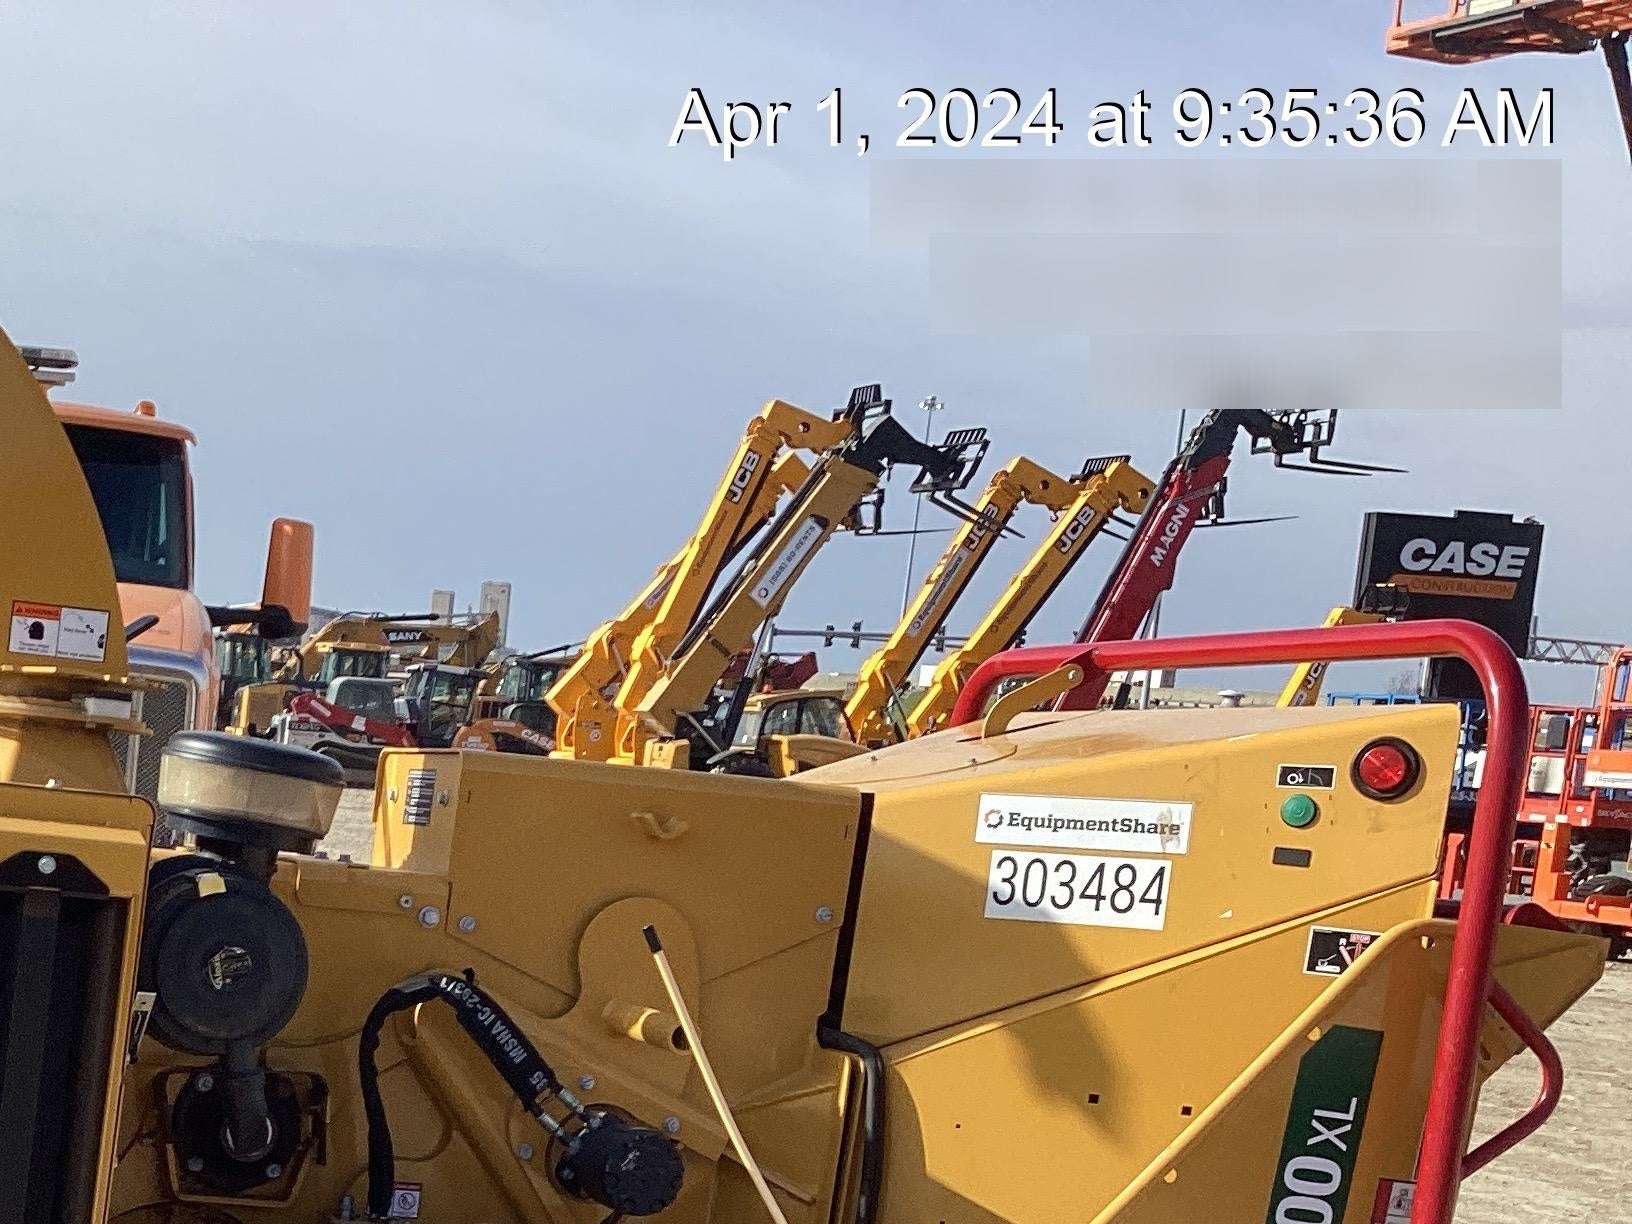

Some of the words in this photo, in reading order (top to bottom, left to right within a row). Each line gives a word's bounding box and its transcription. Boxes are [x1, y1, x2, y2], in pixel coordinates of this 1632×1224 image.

[728, 450, 762, 504] JCB
[1057, 504, 1097, 554] JCB
[1150, 503, 1190, 568] MAGNI
[1399, 537, 1530, 579] CASE
[388, 631, 423, 641] SANY
[1006, 811, 1181, 837] EquipmentShare
[992, 855, 1167, 916] 303484
